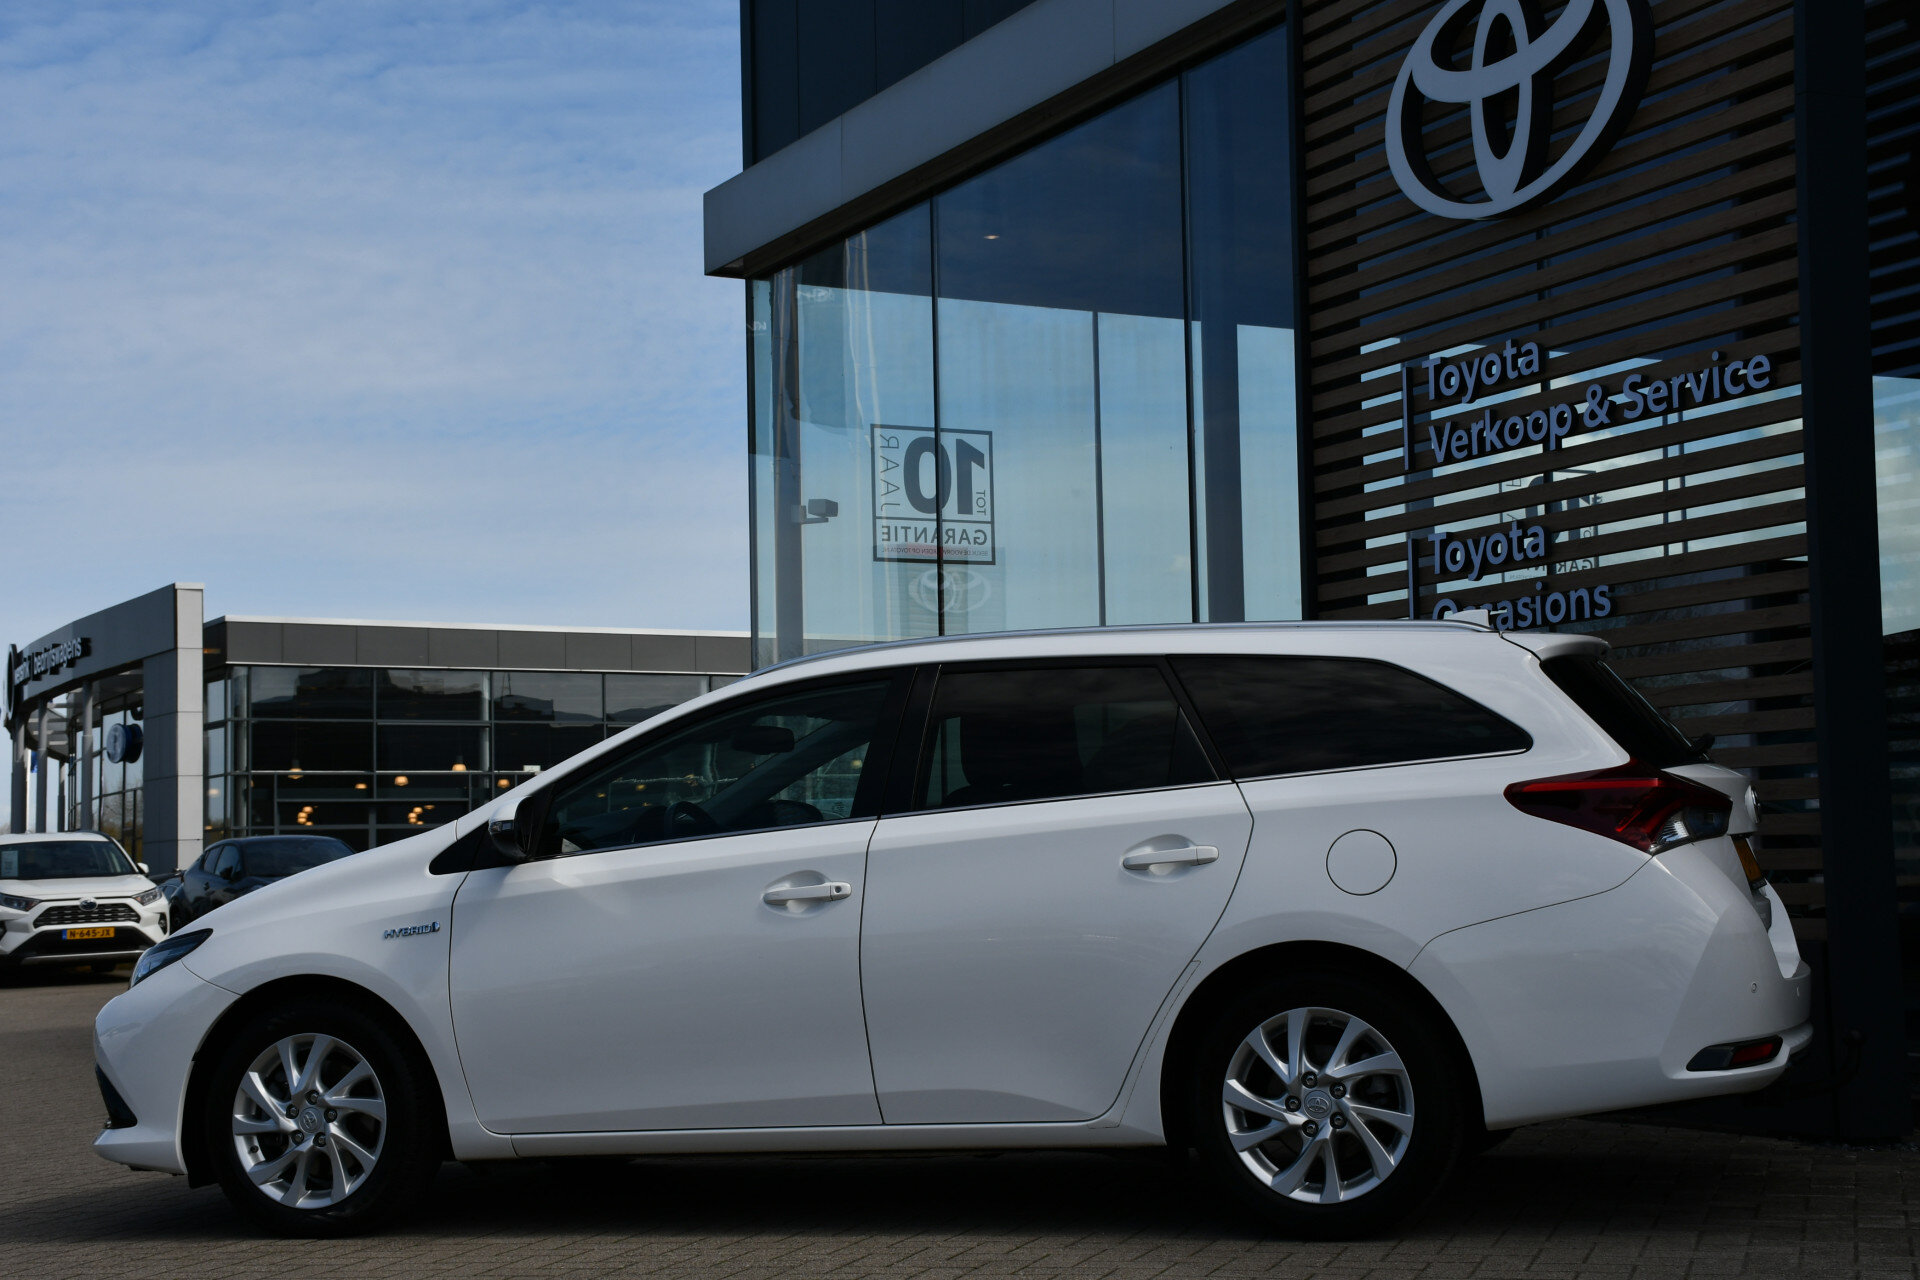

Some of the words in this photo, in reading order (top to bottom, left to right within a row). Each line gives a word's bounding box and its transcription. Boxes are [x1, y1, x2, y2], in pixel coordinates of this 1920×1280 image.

[1421, 339, 1540, 404] Toyota
[1428, 403, 1572, 463] Verkoop
[1583, 384, 1611, 428] &
[1622, 351, 1771, 419] Service
[1427, 520, 1546, 581] Toyota
[1432, 581, 1612, 630] asions
[69, 929, 110, 938] N-645-JX
